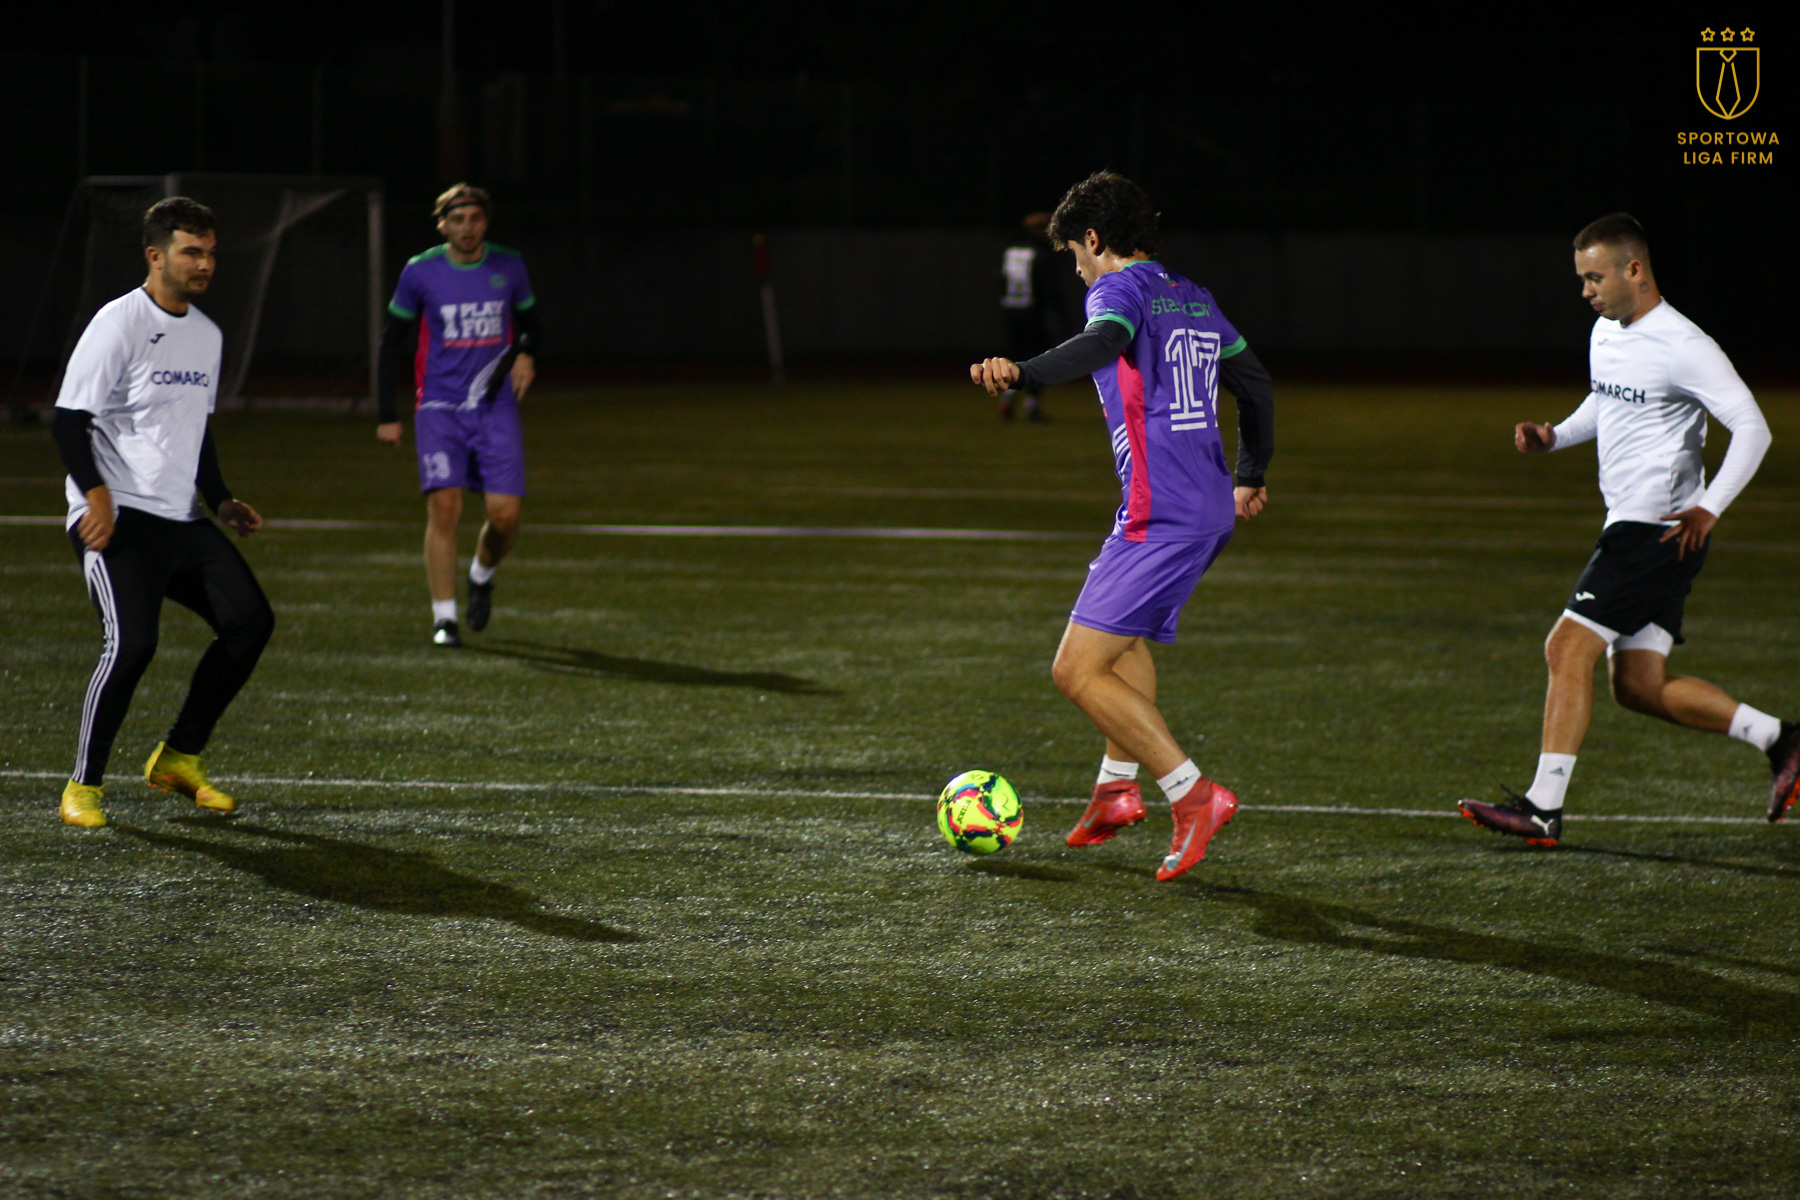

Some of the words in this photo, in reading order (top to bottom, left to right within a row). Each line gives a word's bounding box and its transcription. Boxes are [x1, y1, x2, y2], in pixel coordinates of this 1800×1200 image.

[460, 300, 505, 318] PLAY
[460, 317, 503, 339] FOR
[150, 370, 210, 388] COMARC
[1164, 328, 1221, 432] 17
[1590, 380, 1646, 404] OMARCH
